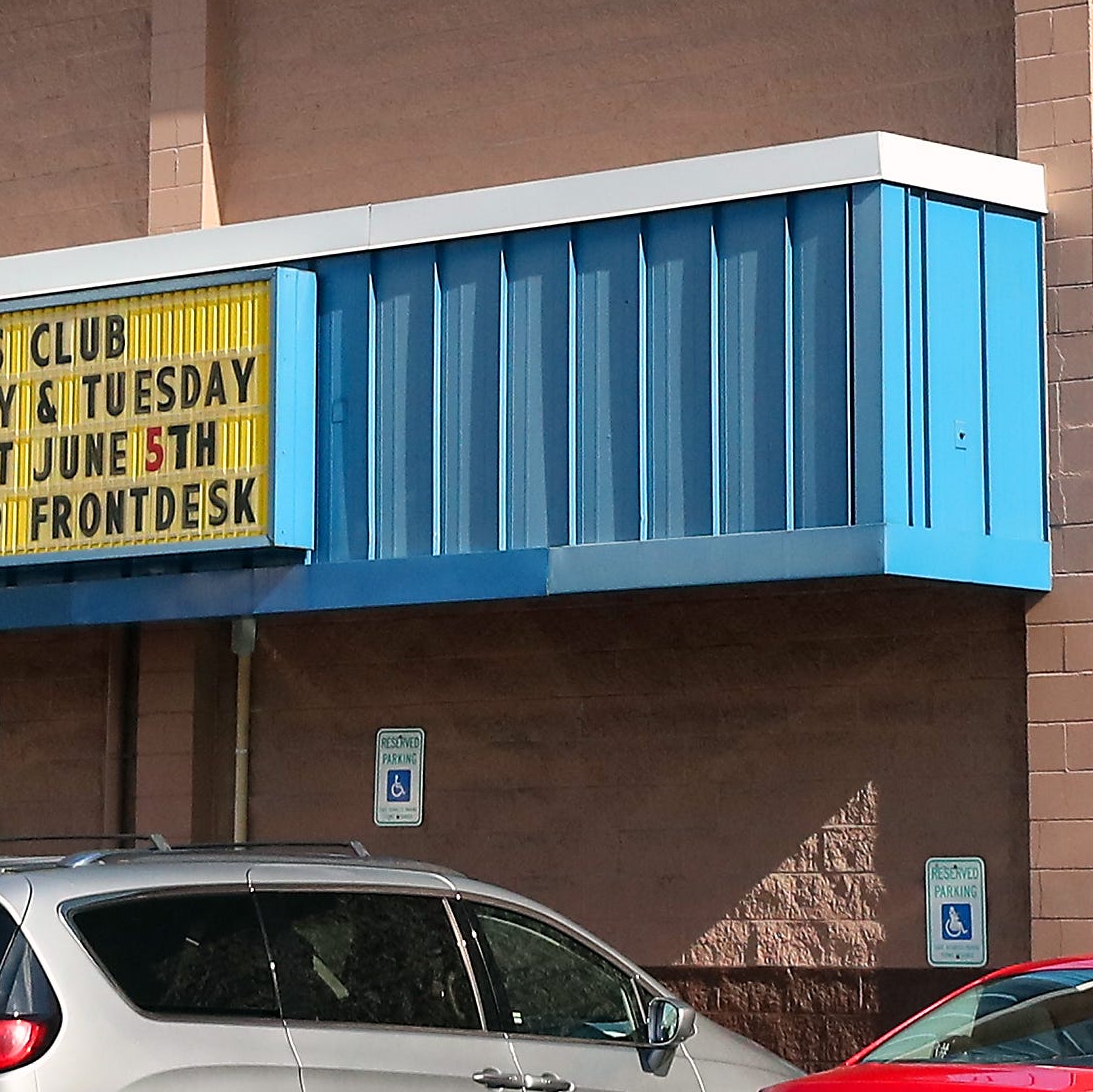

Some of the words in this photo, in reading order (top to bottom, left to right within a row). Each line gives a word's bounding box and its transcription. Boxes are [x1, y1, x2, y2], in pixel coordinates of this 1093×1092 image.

[30, 315, 126, 367] CLUB
[37, 379, 57, 424] &
[82, 357, 256, 419] TUESDAY
[33, 431, 128, 482] JUNE
[145, 421, 216, 472] 5TH
[31, 477, 256, 542] FRONTDESK
[380, 736, 420, 750] RESERVED
[382, 752, 418, 765] PARKING
[931, 866, 979, 881] RESERVED
[934, 884, 978, 898] PARKING
